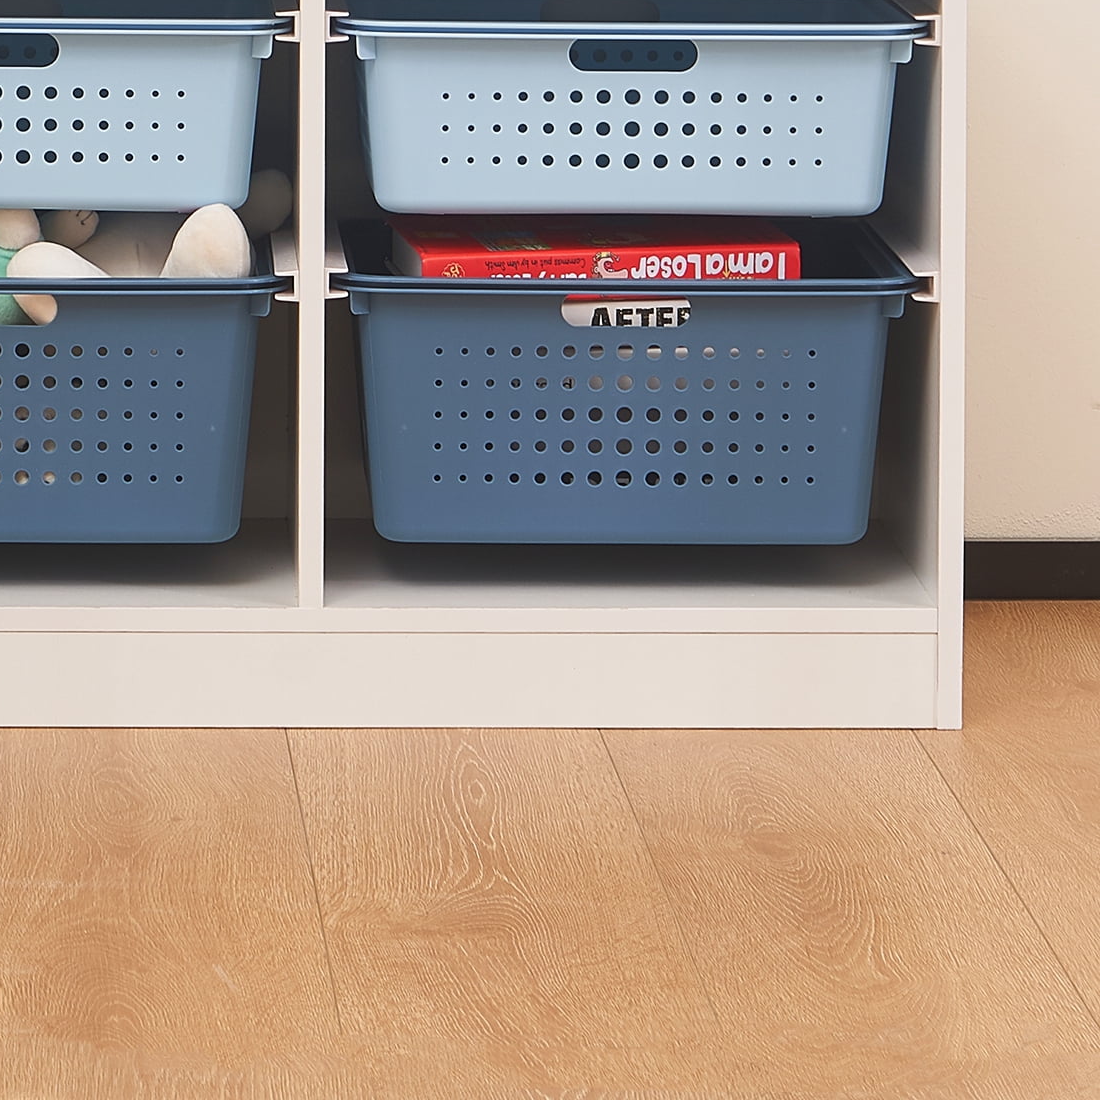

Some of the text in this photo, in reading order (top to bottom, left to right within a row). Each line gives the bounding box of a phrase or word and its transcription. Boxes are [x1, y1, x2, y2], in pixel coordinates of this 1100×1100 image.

[485, 261, 505, 270] Smith
[522, 258, 529, 270] by
[531, 260, 538, 268] in
[541, 257, 552, 268] put
[554, 258, 586, 268] Commas
[631, 252, 785, 280] I am a Loser
